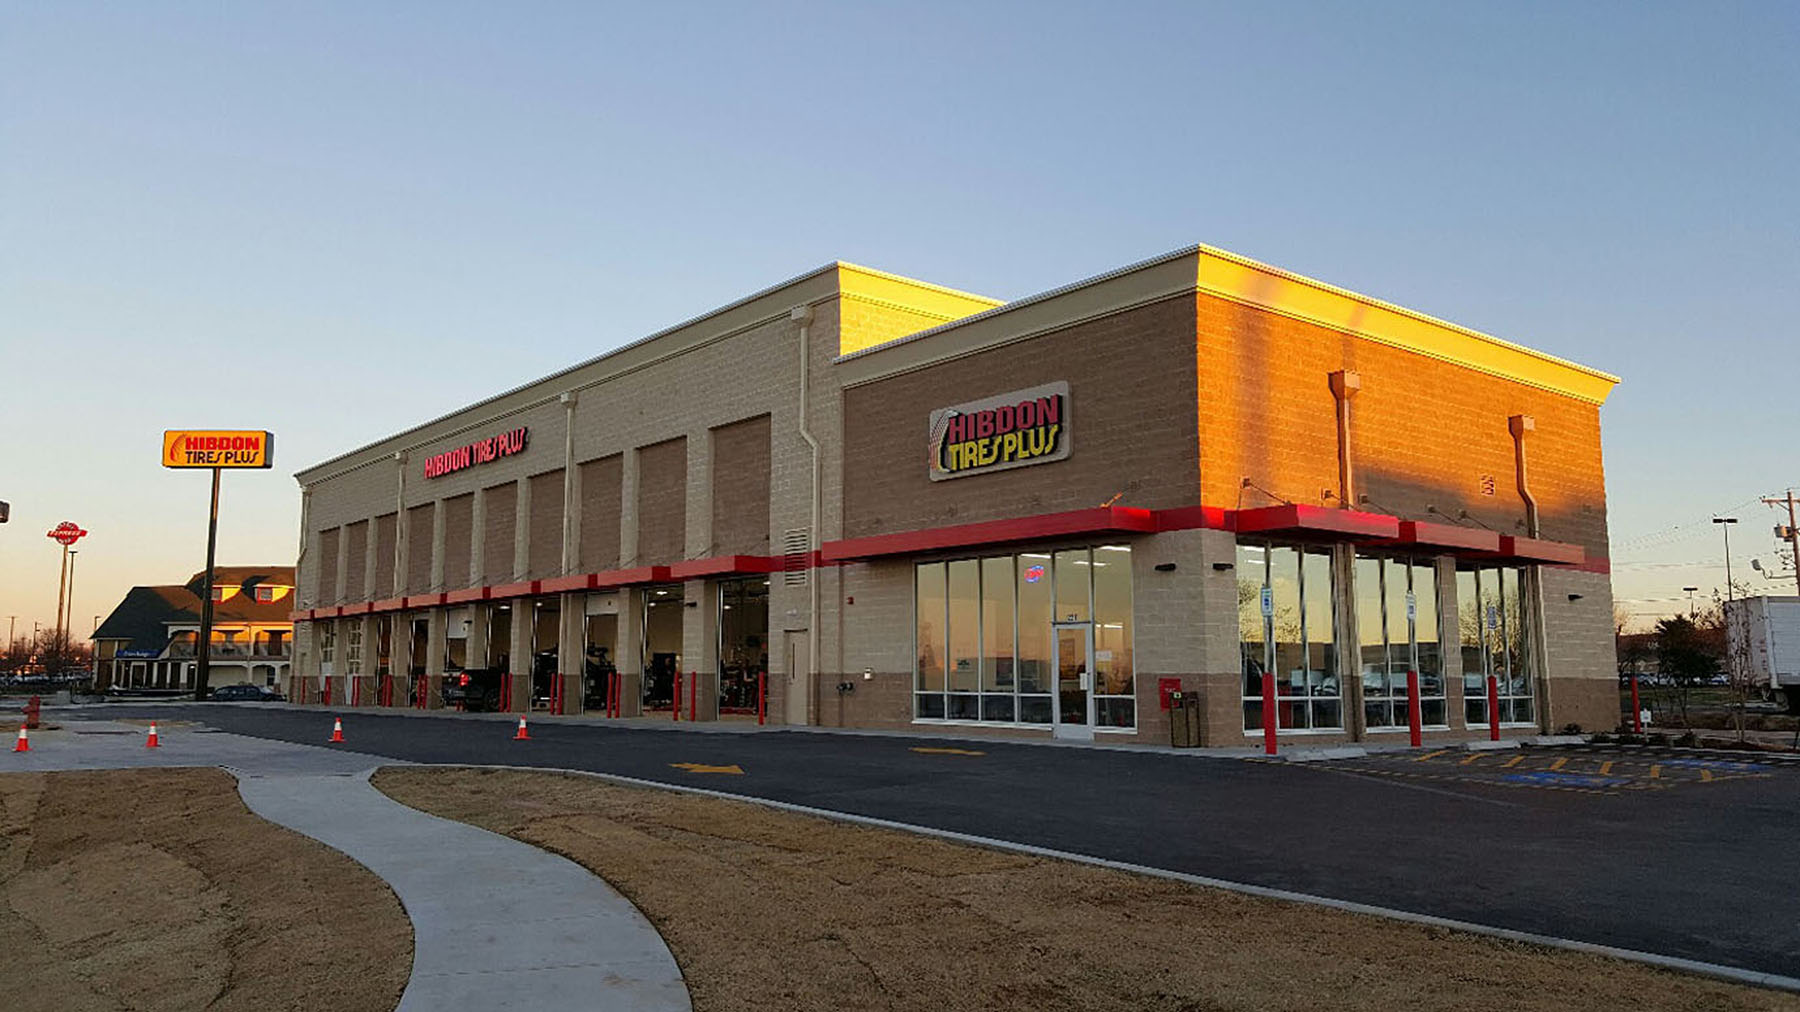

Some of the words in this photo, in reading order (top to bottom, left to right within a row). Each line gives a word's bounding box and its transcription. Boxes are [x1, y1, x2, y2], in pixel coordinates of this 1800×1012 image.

[185, 436, 260, 450] HIBDON
[949, 394, 1060, 445] HIBDON
[185, 451, 223, 464] TIRES
[224, 451, 259, 464] PLUS
[424, 445, 470, 479] HIBDON
[472, 436, 498, 464] TIRES
[498, 427, 526, 457] PLUS
[949, 434, 1003, 471] TIRES
[1003, 423, 1060, 462] PLUS
